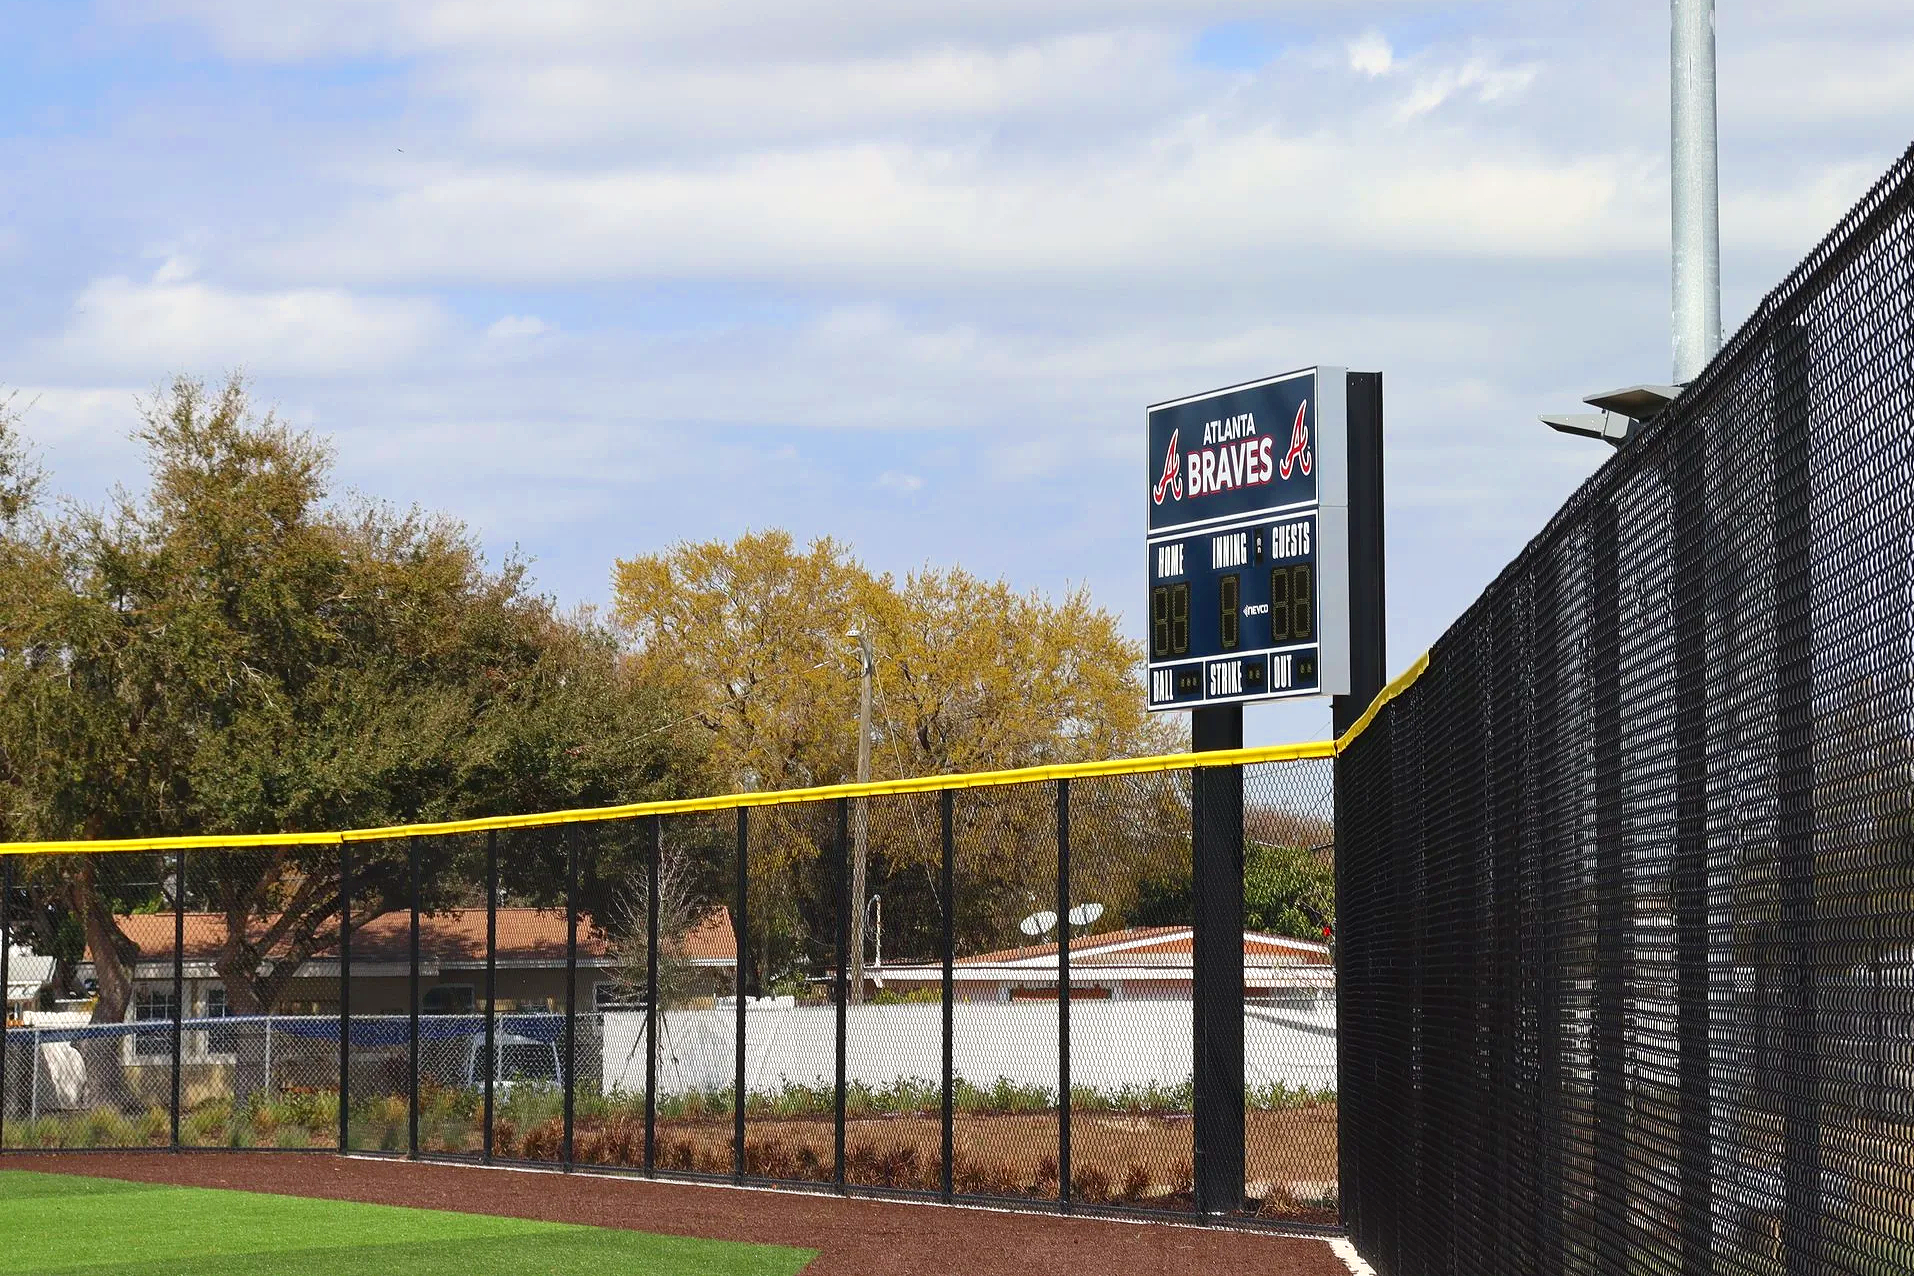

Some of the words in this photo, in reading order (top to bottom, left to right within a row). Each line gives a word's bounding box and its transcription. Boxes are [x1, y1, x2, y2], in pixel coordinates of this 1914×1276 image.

[1203, 412, 1256, 446] ATLANTA
[1187, 435, 1273, 498] BRAVES
[1212, 532, 1248, 569] INNING
[1272, 521, 1310, 560] GUESTS
[1158, 543, 1184, 578] HOME
[1153, 669, 1174, 702] BALL
[1210, 660, 1243, 696] STRIKE
[1273, 654, 1293, 689] OUT
